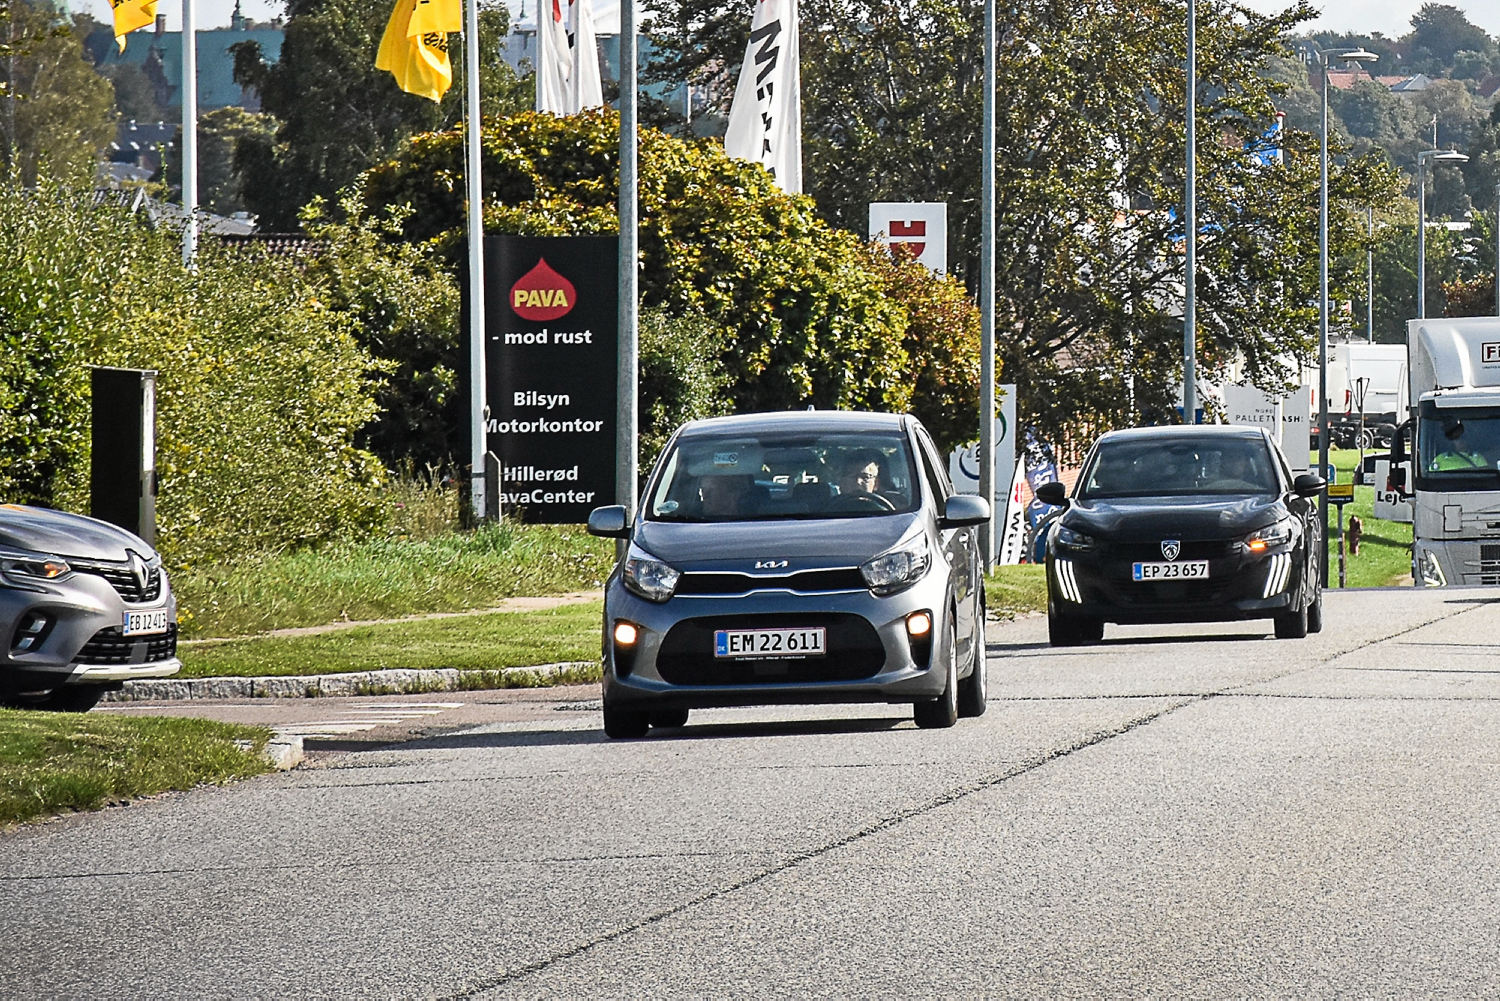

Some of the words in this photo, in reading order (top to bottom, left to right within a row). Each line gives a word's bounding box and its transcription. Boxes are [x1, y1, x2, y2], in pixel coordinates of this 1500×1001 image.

[514, 290, 568, 307] PAVA
[504, 329, 548, 344] mod
[553, 329, 592, 344] rust
[513, 391, 570, 409] Bilsyn
[504, 466, 579, 481] Hillerød
[499, 489, 595, 504] avaCenter
[1143, 565, 1160, 578] EP
[1163, 565, 1179, 578] 23
[1182, 563, 1207, 576] 657
[130, 615, 141, 630] EB
[143, 614, 152, 629] 12
[729, 634, 755, 653] EM
[760, 633, 782, 651] 22
[786, 632, 821, 650] 611
